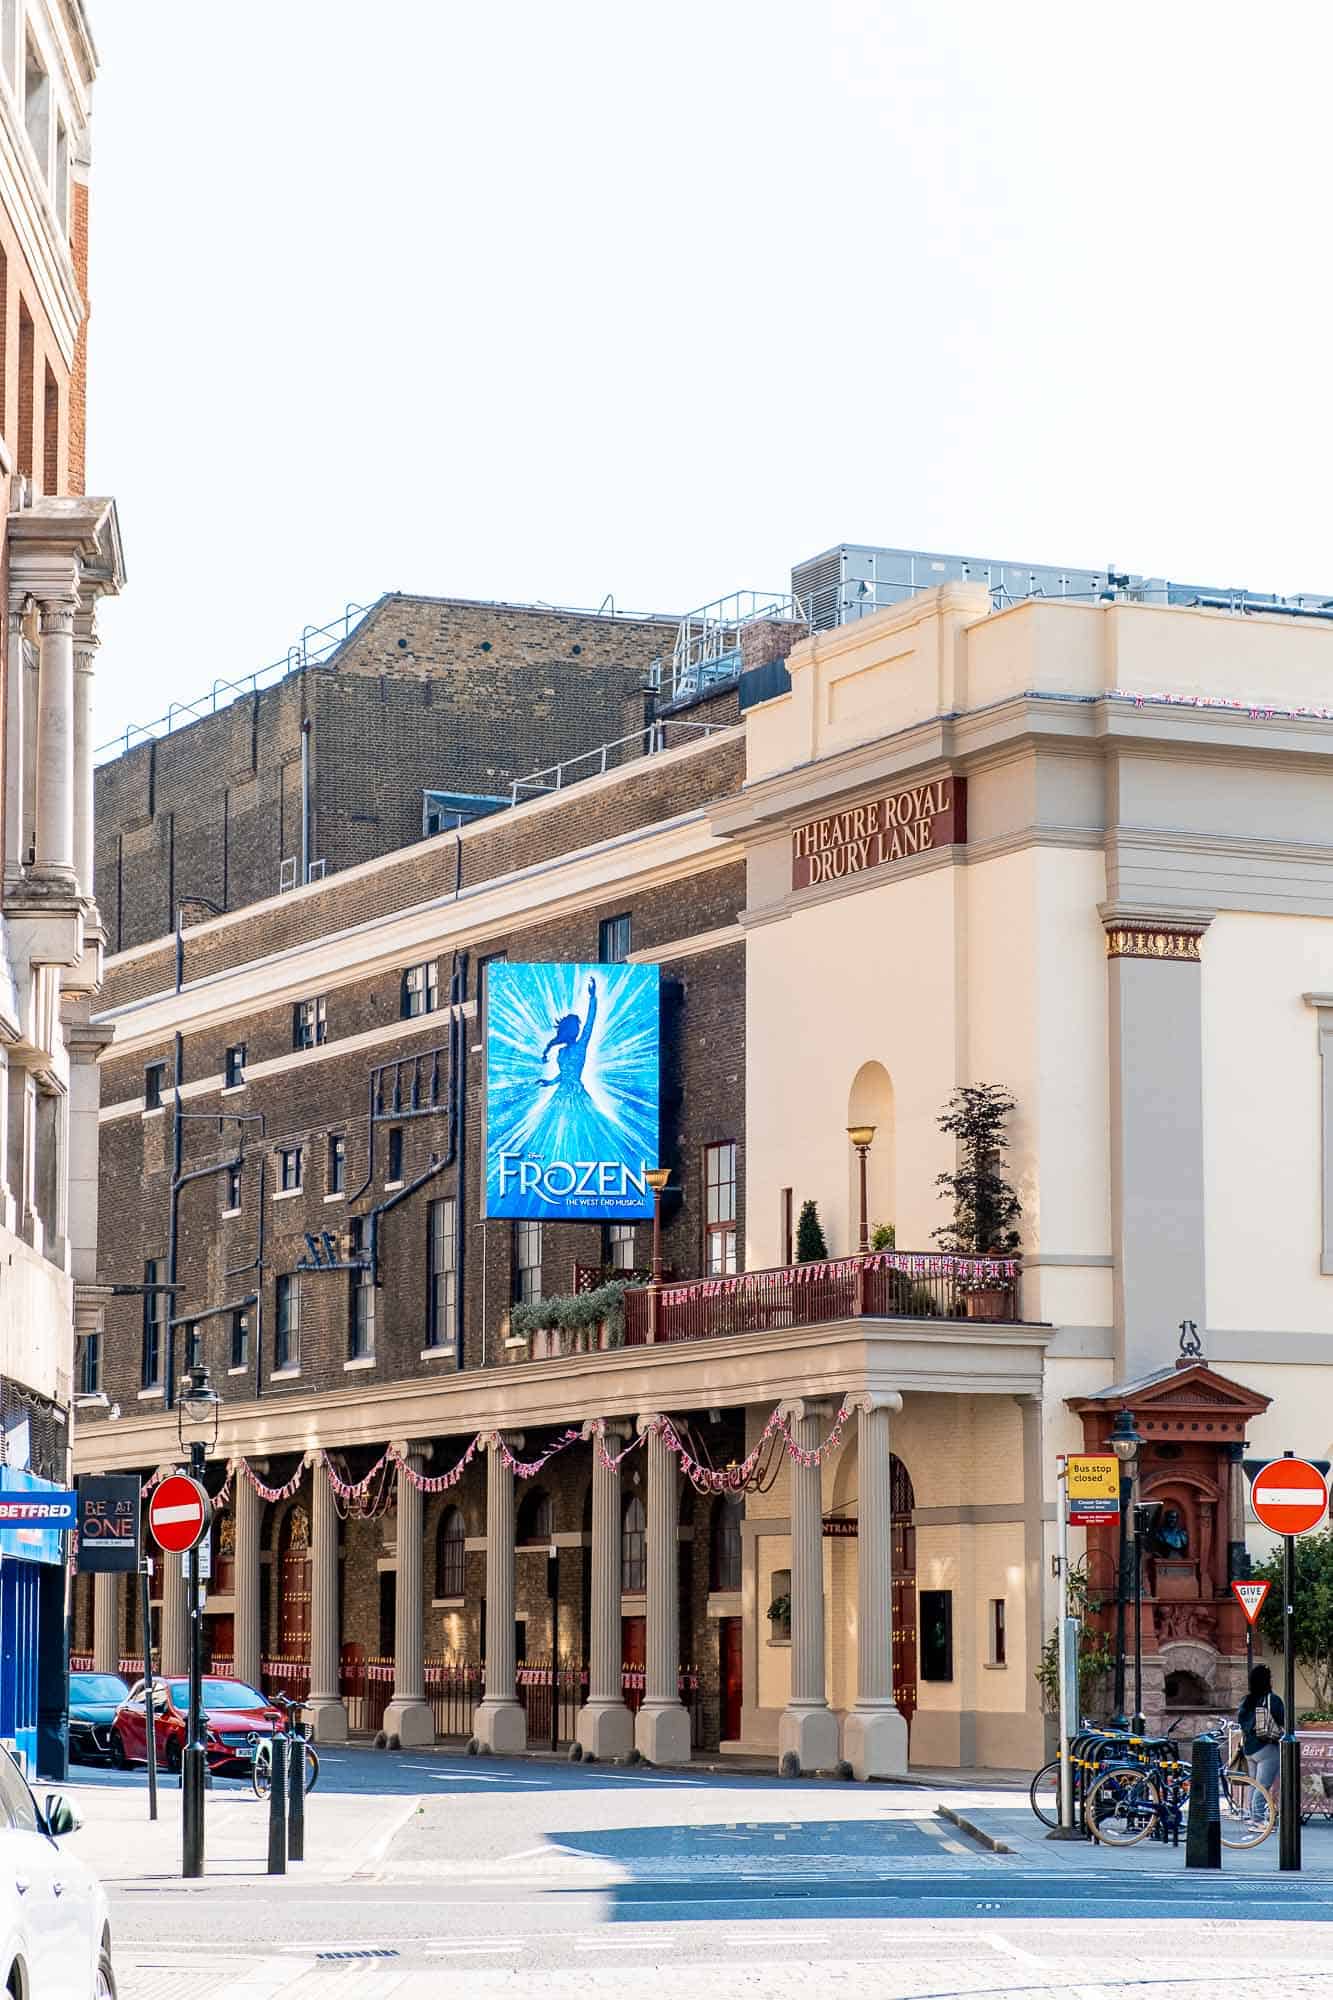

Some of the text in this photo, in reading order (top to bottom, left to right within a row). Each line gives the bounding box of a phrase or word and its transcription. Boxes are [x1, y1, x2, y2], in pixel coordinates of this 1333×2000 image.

[793, 781, 950, 859] THEATRE ROYAL
[808, 817, 934, 885] DRURY LANE
[499, 1152, 647, 1204] FROZEN
[1074, 1464, 1112, 1474] Bus stop
[1074, 1474, 1103, 1482] closed
[0, 1504, 71, 1518] BETFRED
[84, 1500, 107, 1515] BE
[83, 1518, 134, 1537] ONE
[823, 1523, 858, 1534] NTRAN
[1240, 1587, 1262, 1596] GIVE
